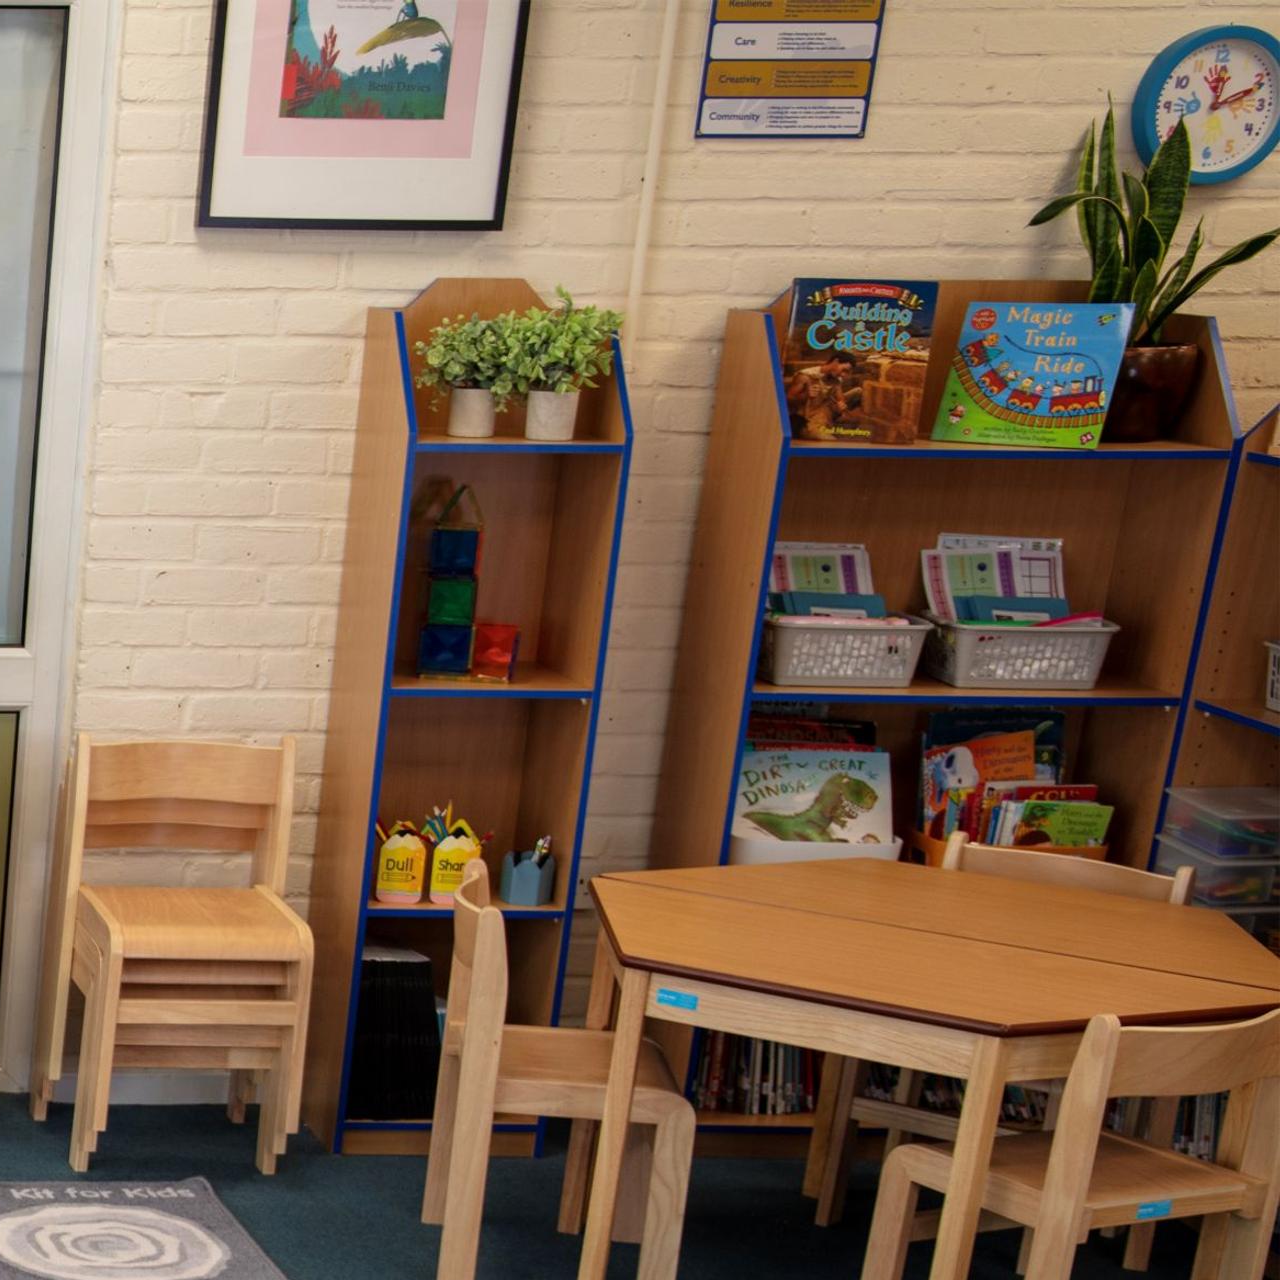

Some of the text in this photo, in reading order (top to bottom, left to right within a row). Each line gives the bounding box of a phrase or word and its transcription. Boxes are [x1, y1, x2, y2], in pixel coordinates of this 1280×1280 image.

[735, 37, 756, 46] Care
[1215, 49, 1231, 63] 12
[396, 80, 431, 92] Davies
[719, 74, 761, 85] Creativity
[1175, 75, 1190, 89] 10
[1163, 101, 1172, 113] 9
[1256, 98, 1265, 112] 3
[709, 111, 761, 122] Community
[1244, 123, 1254, 135] 4
[1202, 146, 1212, 159] 6
[1225, 139, 1235, 153] 5
[824, 300, 913, 326] Building
[1007, 306, 1073, 330] Magic
[806, 320, 912, 352] Castle
[1025, 329, 1078, 347] Train
[1034, 355, 1085, 373] Ride
[743, 760, 867, 787] DIRTY GREAT
[742, 775, 812, 806] DINOSA
[385, 857, 414, 872] Dull
[439, 859, 464, 871] Shar
[10, 1186, 196, 1200] Kit for Kids
